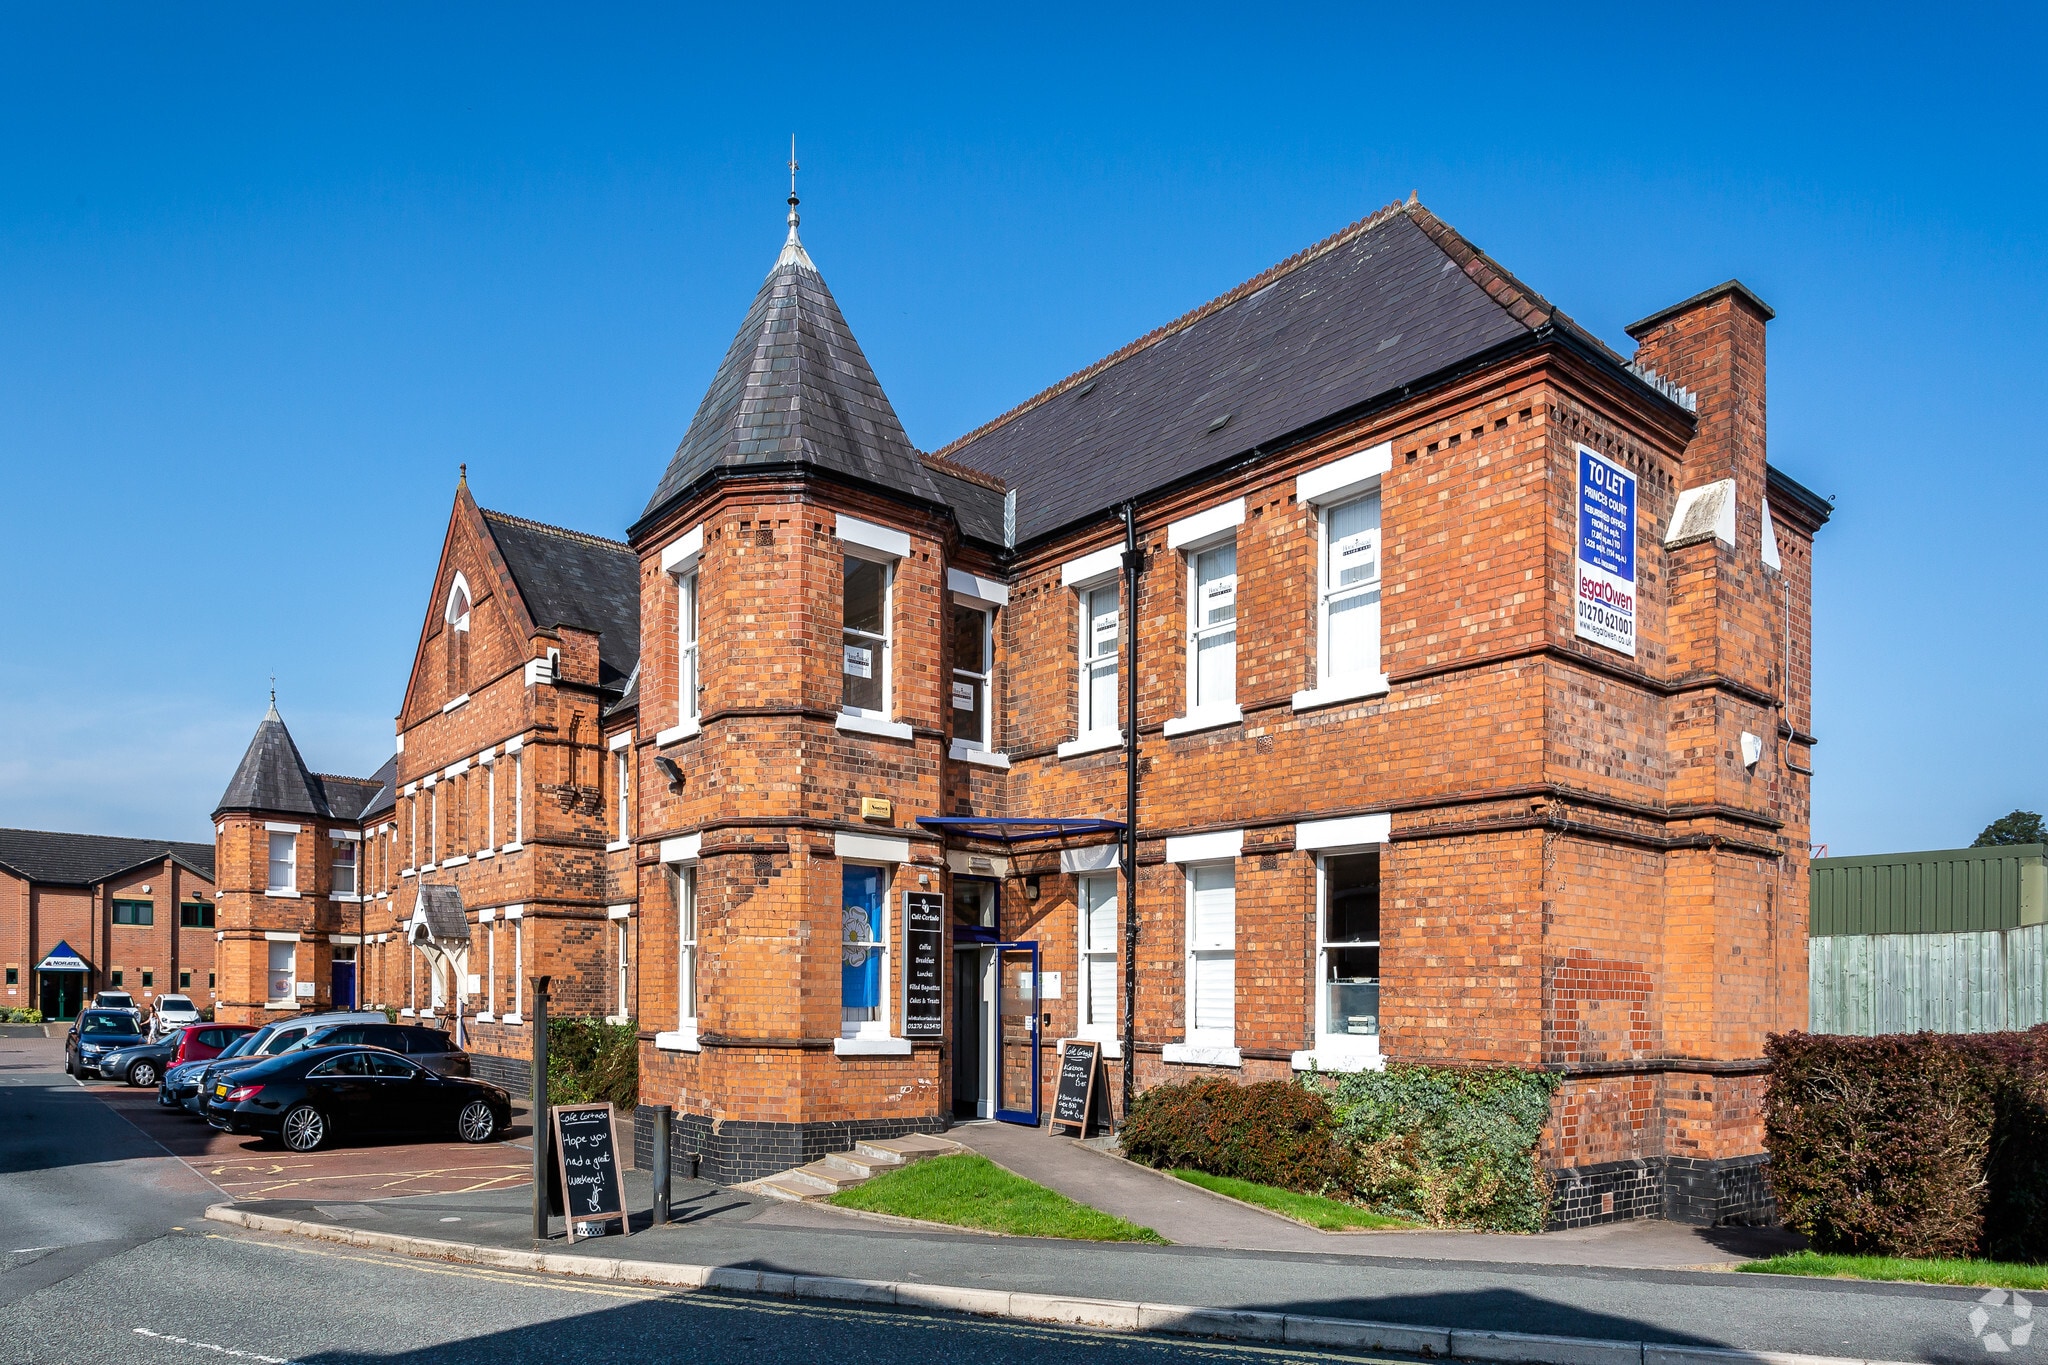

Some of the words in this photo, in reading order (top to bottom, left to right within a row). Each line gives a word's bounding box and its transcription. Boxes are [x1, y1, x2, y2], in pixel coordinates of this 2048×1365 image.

[1589, 460, 1604, 485] TO
[1606, 470, 1625, 496] LET
[1584, 485, 1607, 506] PRINCES
[1608, 498, 1627, 516] COURT
[1579, 600, 1604, 624] 01270
[1605, 612, 1632, 636] 621001
[580, 1111, 608, 1121] Cortado
[562, 1133, 587, 1149] Hope
[590, 1132, 607, 1147] you
[564, 1153, 582, 1167] had
[585, 1158, 591, 1166] a
[593, 1151, 610, 1170] great
